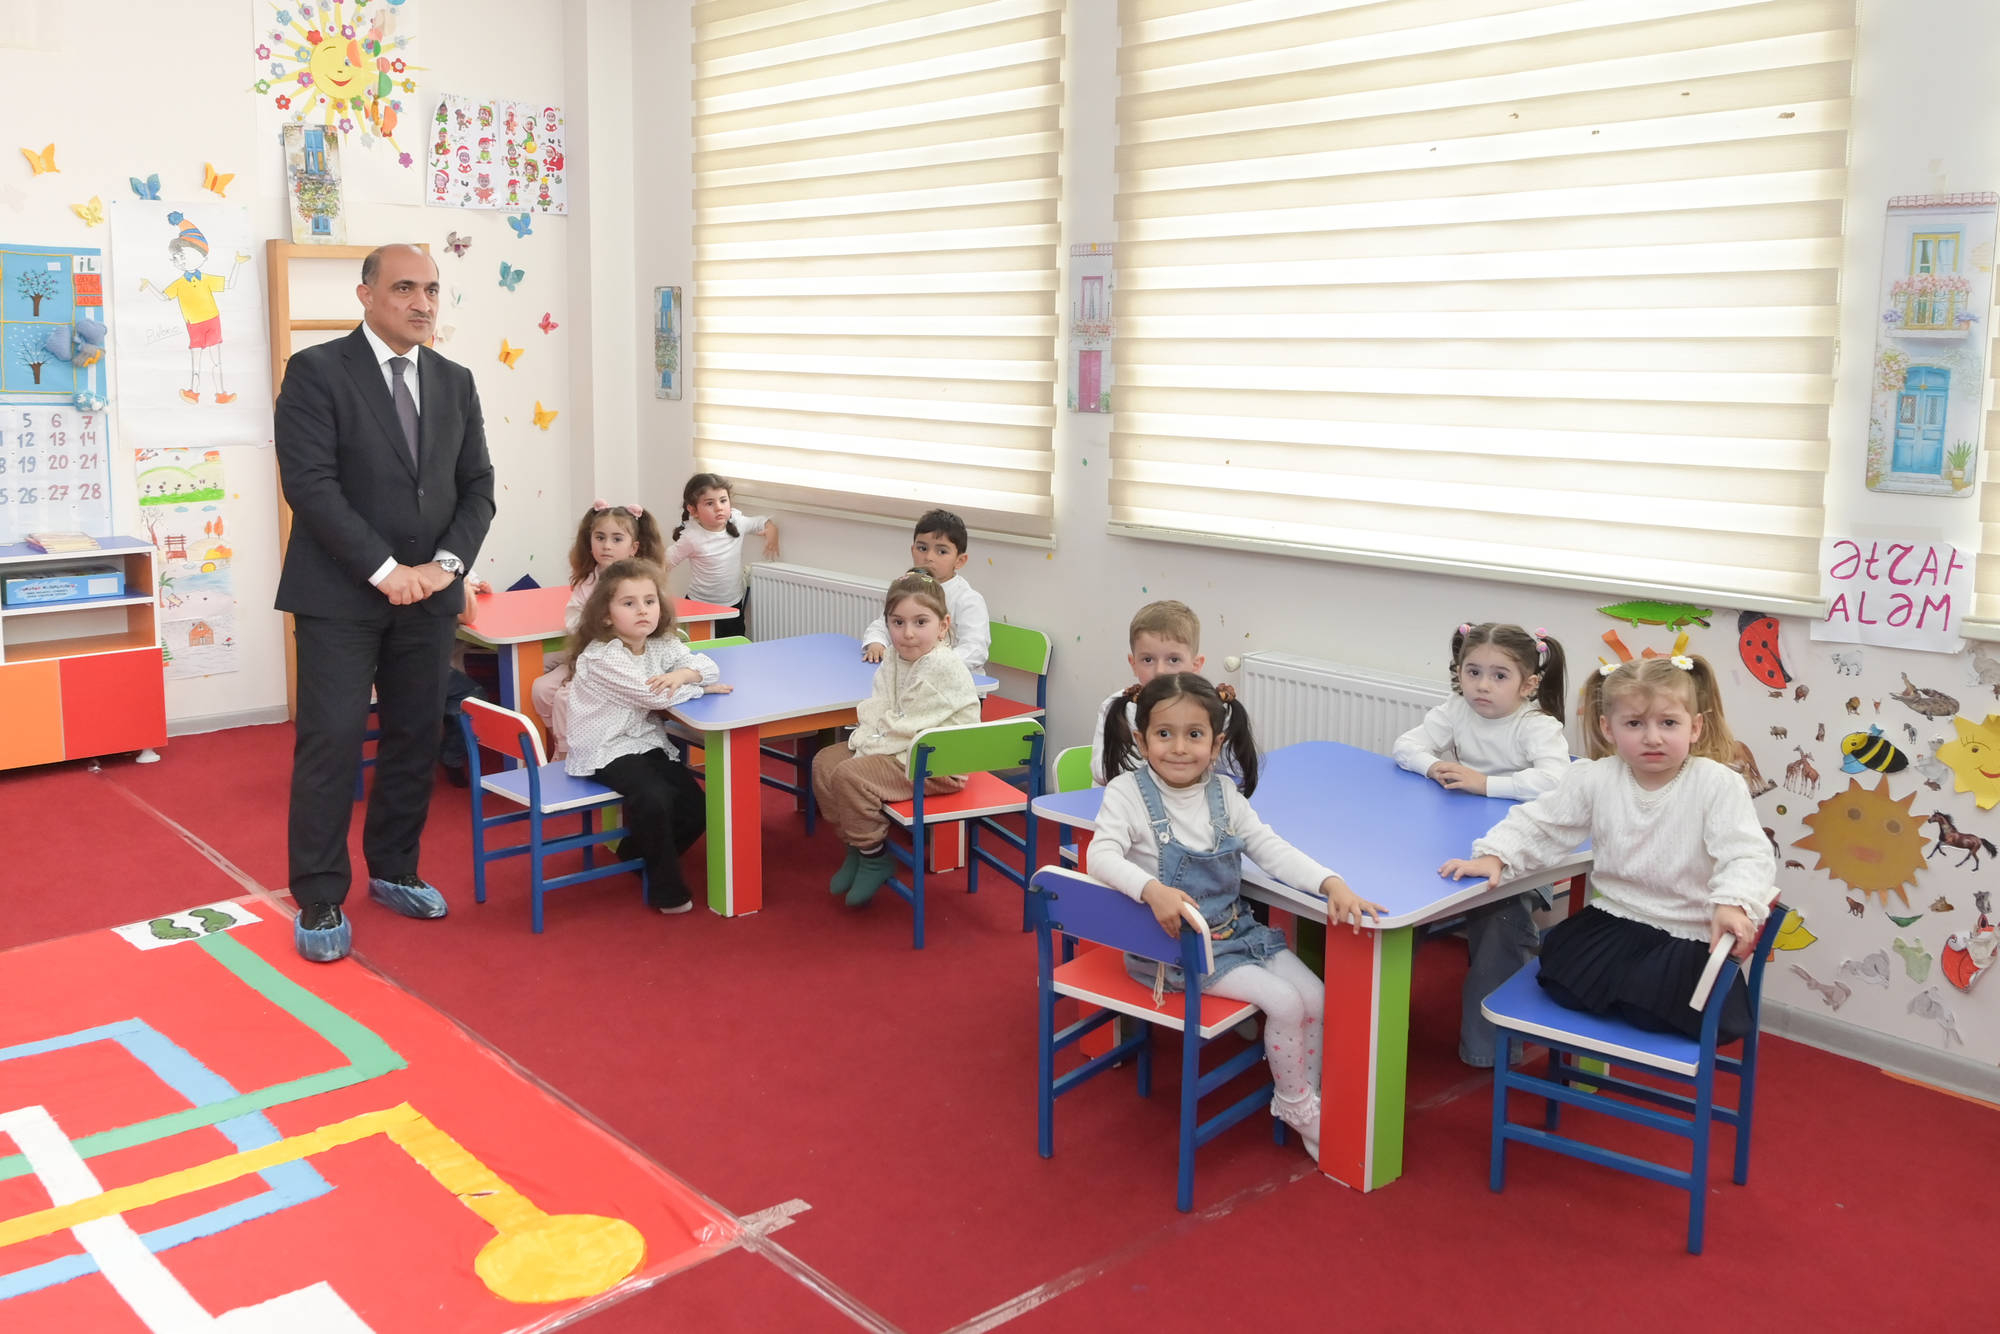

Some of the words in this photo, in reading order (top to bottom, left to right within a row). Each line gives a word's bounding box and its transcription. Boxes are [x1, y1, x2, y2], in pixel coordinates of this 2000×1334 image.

[23, 413, 32, 428] 5
[51, 413, 62, 428] 6
[81, 415, 93, 429] 7
[17, 432, 35, 448] 12
[49, 432, 66, 446] 13
[80, 431, 96, 447] 14
[18, 456, 36, 473] 19
[48, 455, 69, 470] 20
[79, 454, 98, 469] 21
[18, 487, 38, 504] 26
[48, 484, 70, 501] 27
[79, 483, 102, 500] 28
